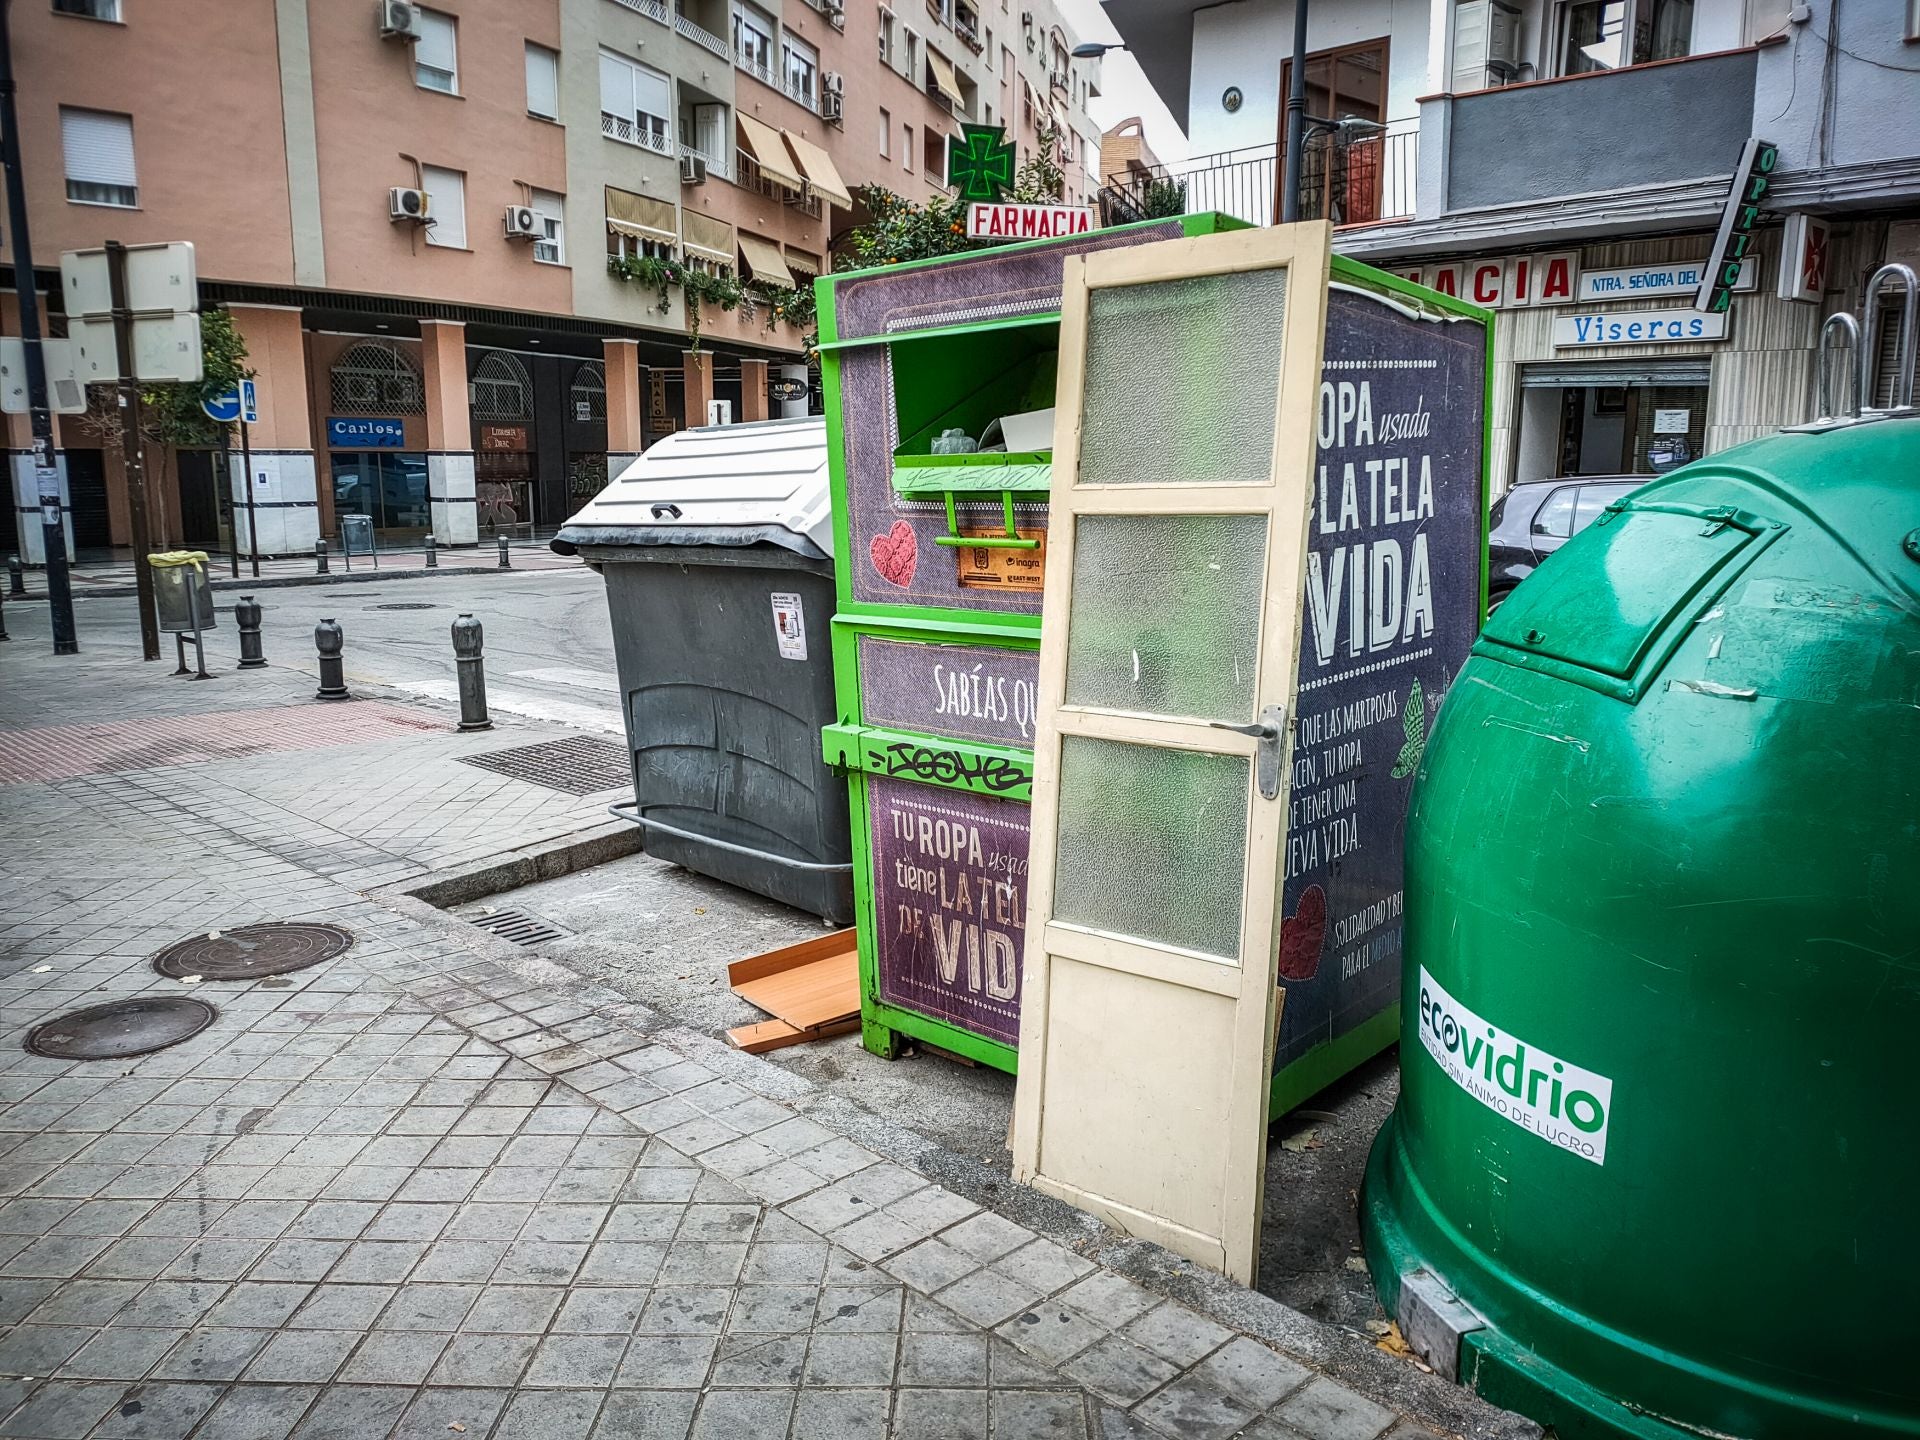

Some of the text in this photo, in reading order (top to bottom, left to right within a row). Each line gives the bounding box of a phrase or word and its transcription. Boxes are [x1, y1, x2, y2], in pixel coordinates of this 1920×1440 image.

[975, 205, 1089, 238] FARMACIA
[1397, 257, 1570, 303] ACIA
[1591, 269, 1700, 292] NTRA. SEÑORA DEL
[1574, 316, 1704, 342] Viseras
[334, 421, 395, 435] Carlos
[1319, 454, 1435, 535] LA TELA
[1016, 556, 1041, 570] inagra
[1304, 533, 1434, 667] VIDA
[934, 662, 1008, 722] SABÍAS
[1302, 713, 1322, 755] QUE
[1324, 706, 1342, 741] LAS
[1343, 689, 1398, 735] MARIPOSAS
[1322, 747, 1336, 778] TU
[1338, 738, 1362, 774] ROPA
[1301, 787, 1332, 826] TENER
[1334, 779, 1357, 813] UNA
[890, 808, 915, 842] TU
[918, 814, 984, 868] ROPA
[1322, 811, 1362, 864] VIDA.
[895, 857, 937, 896] tiene
[939, 866, 974, 916] LA
[898, 904, 925, 939] DE
[1335, 899, 1386, 949] SOLIDARIDAD
[1387, 895, 1392, 921] Y
[1342, 948, 1361, 981] PARA
[1362, 943, 1370, 970] EL
[1420, 986, 1605, 1134] ecovidrio
[1421, 1027, 1595, 1158] ENTIDAD SIN ÁNIMO DE LUCRO
